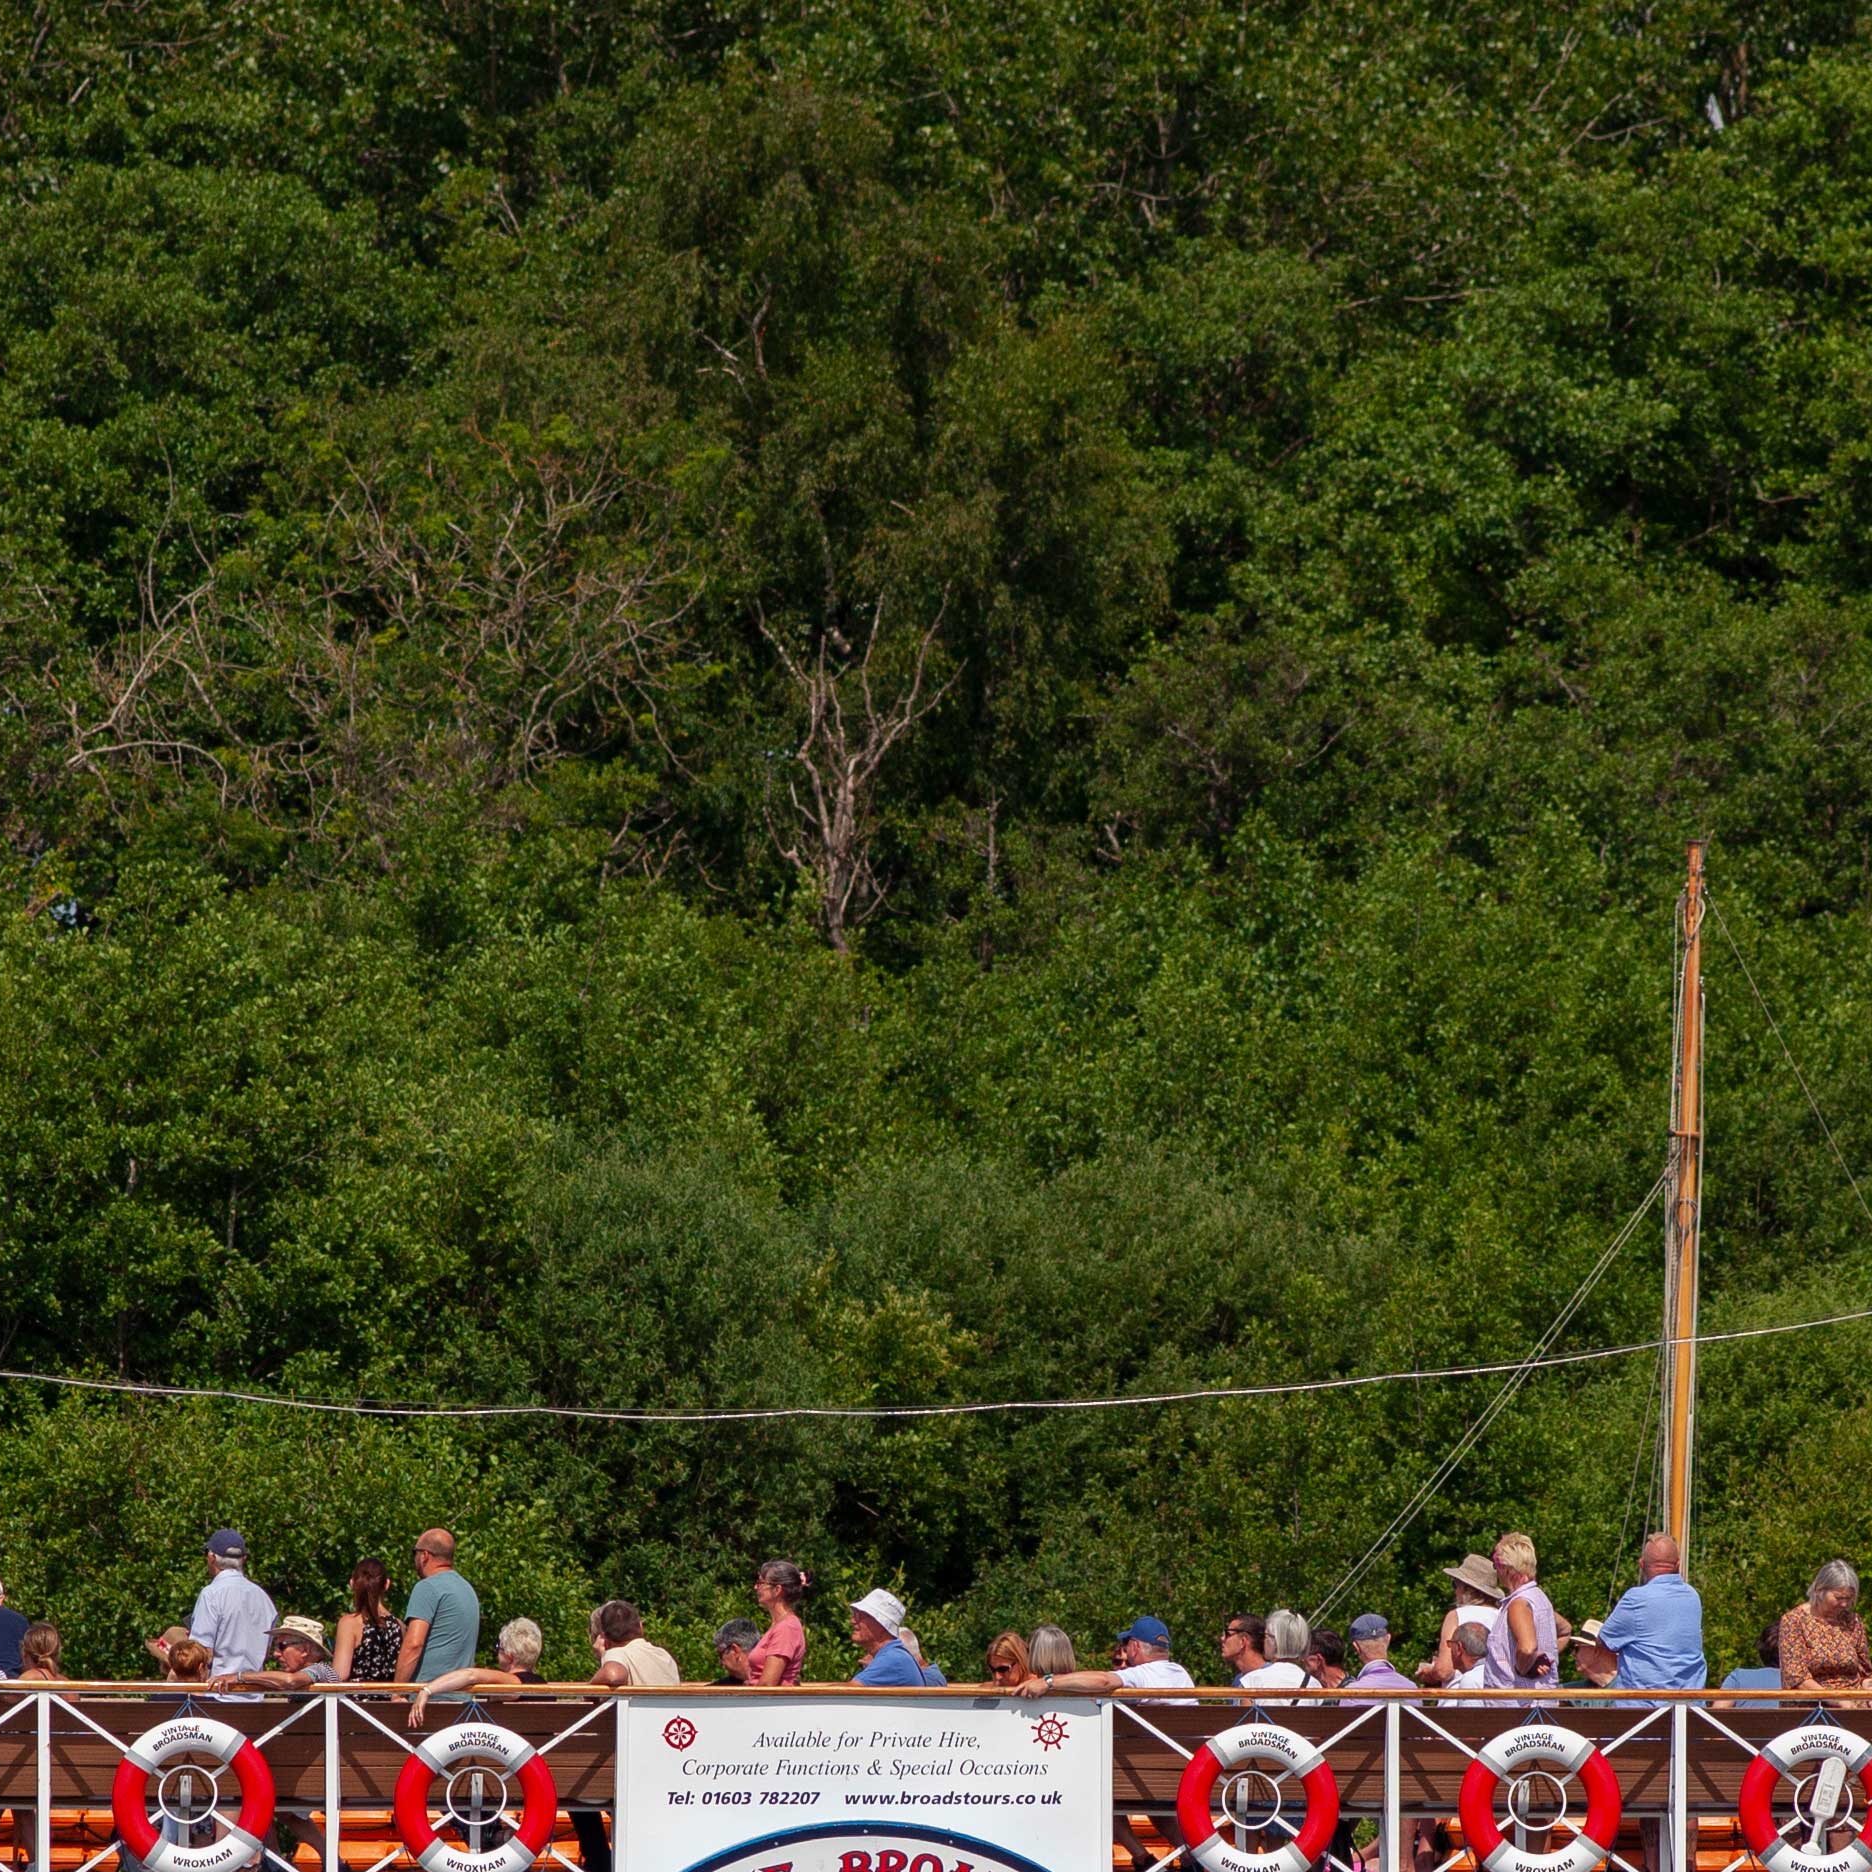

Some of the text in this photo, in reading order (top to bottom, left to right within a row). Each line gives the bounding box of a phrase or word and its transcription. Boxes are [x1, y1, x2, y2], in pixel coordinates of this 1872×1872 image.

[161, 1725, 200, 1737] VINTAGE
[460, 1731, 500, 1743] VINTAGE
[1251, 1731, 1291, 1745] VINTAGE
[1514, 1732, 1553, 1744] VINTAGE
[1801, 1733, 1841, 1744] VINTAGE
[152, 1732, 213, 1752] BROADSMAN
[448, 1739, 510, 1755] BROADSMAN
[752, 1731, 981, 1752] Available for Private Hire,
[1238, 1738, 1298, 1760] BROADSMAN
[1504, 1740, 1565, 1758] BROADSMAN
[1790, 1741, 1852, 1756] BROADSMAN
[682, 1759, 1049, 1780] Corporate Functions & Special Occasions
[667, 1791, 821, 1805] Tel: 01603 782207
[173, 1849, 233, 1868] WROXHAM
[446, 1857, 506, 1872] WROXHAM
